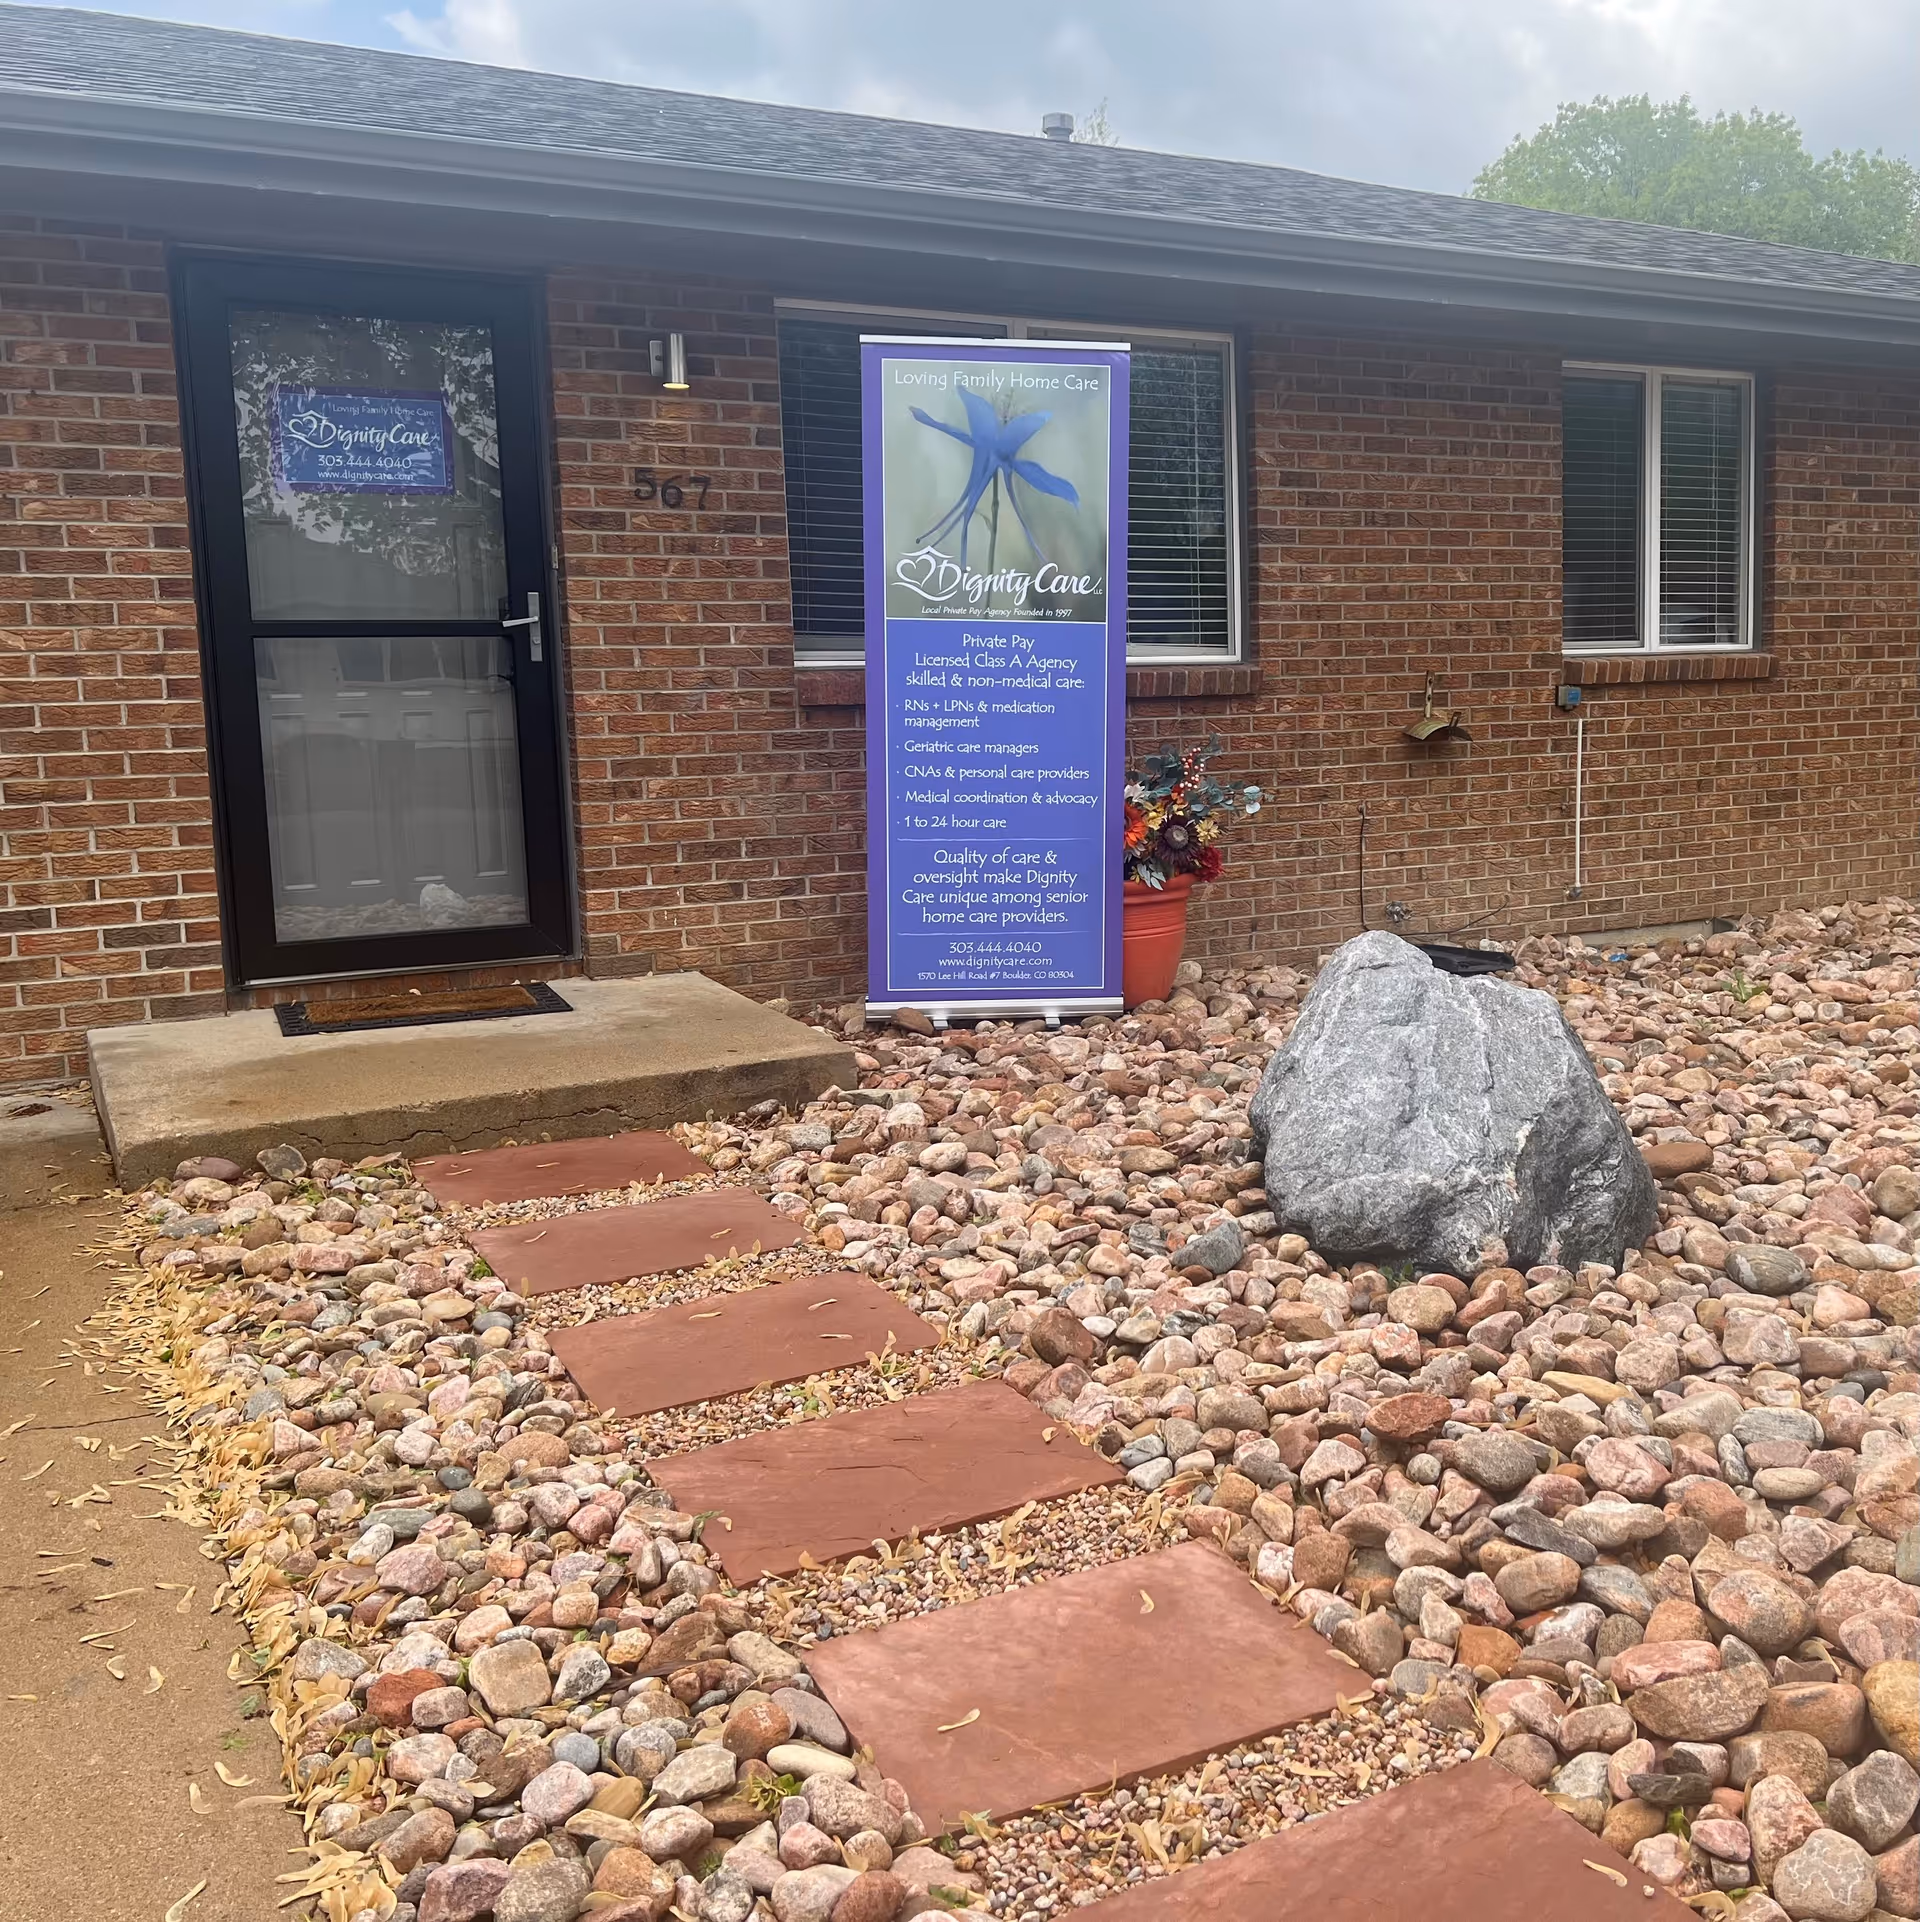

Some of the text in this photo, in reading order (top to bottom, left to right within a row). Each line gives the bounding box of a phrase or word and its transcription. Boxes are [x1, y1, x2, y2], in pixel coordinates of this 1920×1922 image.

[895, 369, 1098, 392] Loving Family Home Care
[332, 404, 359, 416] Loving
[362, 406, 388, 415] Family
[417, 408, 434, 416] Care
[318, 454, 412, 469] 303.444.4040
[318, 470, 414, 481] www.dignitycare.com
[634, 468, 711, 510] 567
[921, 606, 941, 614] Local
[969, 607, 982, 617] Pay
[983, 608, 1011, 617] Agency
[1014, 608, 1043, 616] Founded
[1046, 608, 1053, 616] in
[1055, 609, 1072, 617] 1997
[963, 634, 1035, 652] Private Pay
[915, 651, 1077, 673] Licensed Class A Agency
[906, 671, 1085, 688] skilled & non-medical care:
[904, 700, 929, 711] RNs
[944, 700, 974, 712] LPNs
[977, 701, 988, 713] &
[992, 700, 1054, 714] medication
[904, 716, 980, 730] management
[904, 740, 1039, 757] Geriatric care managers
[904, 765, 1089, 781] CNAs & personal care providers
[905, 789, 1098, 807] Medical coordination & advocacy
[904, 814, 1006, 828] 1 to 24 hour care
[934, 847, 1057, 867] Quality of care &
[913, 869, 1077, 888] oversight make Dignity
[902, 890, 1088, 908] Care unique among senior
[923, 907, 1068, 927] home care providers.
[950, 942, 1041, 953] 303.444.4040
[939, 956, 1052, 969] www.dignitycare.com
[918, 972, 936, 980] 1570
[954, 971, 966, 979] Hill
[969, 971, 987, 979] Road
[990, 971, 1000, 979] #7
[1003, 970, 1032, 979] Boulder,
[1034, 971, 1046, 979] CO
[1049, 971, 1074, 979] 80304
